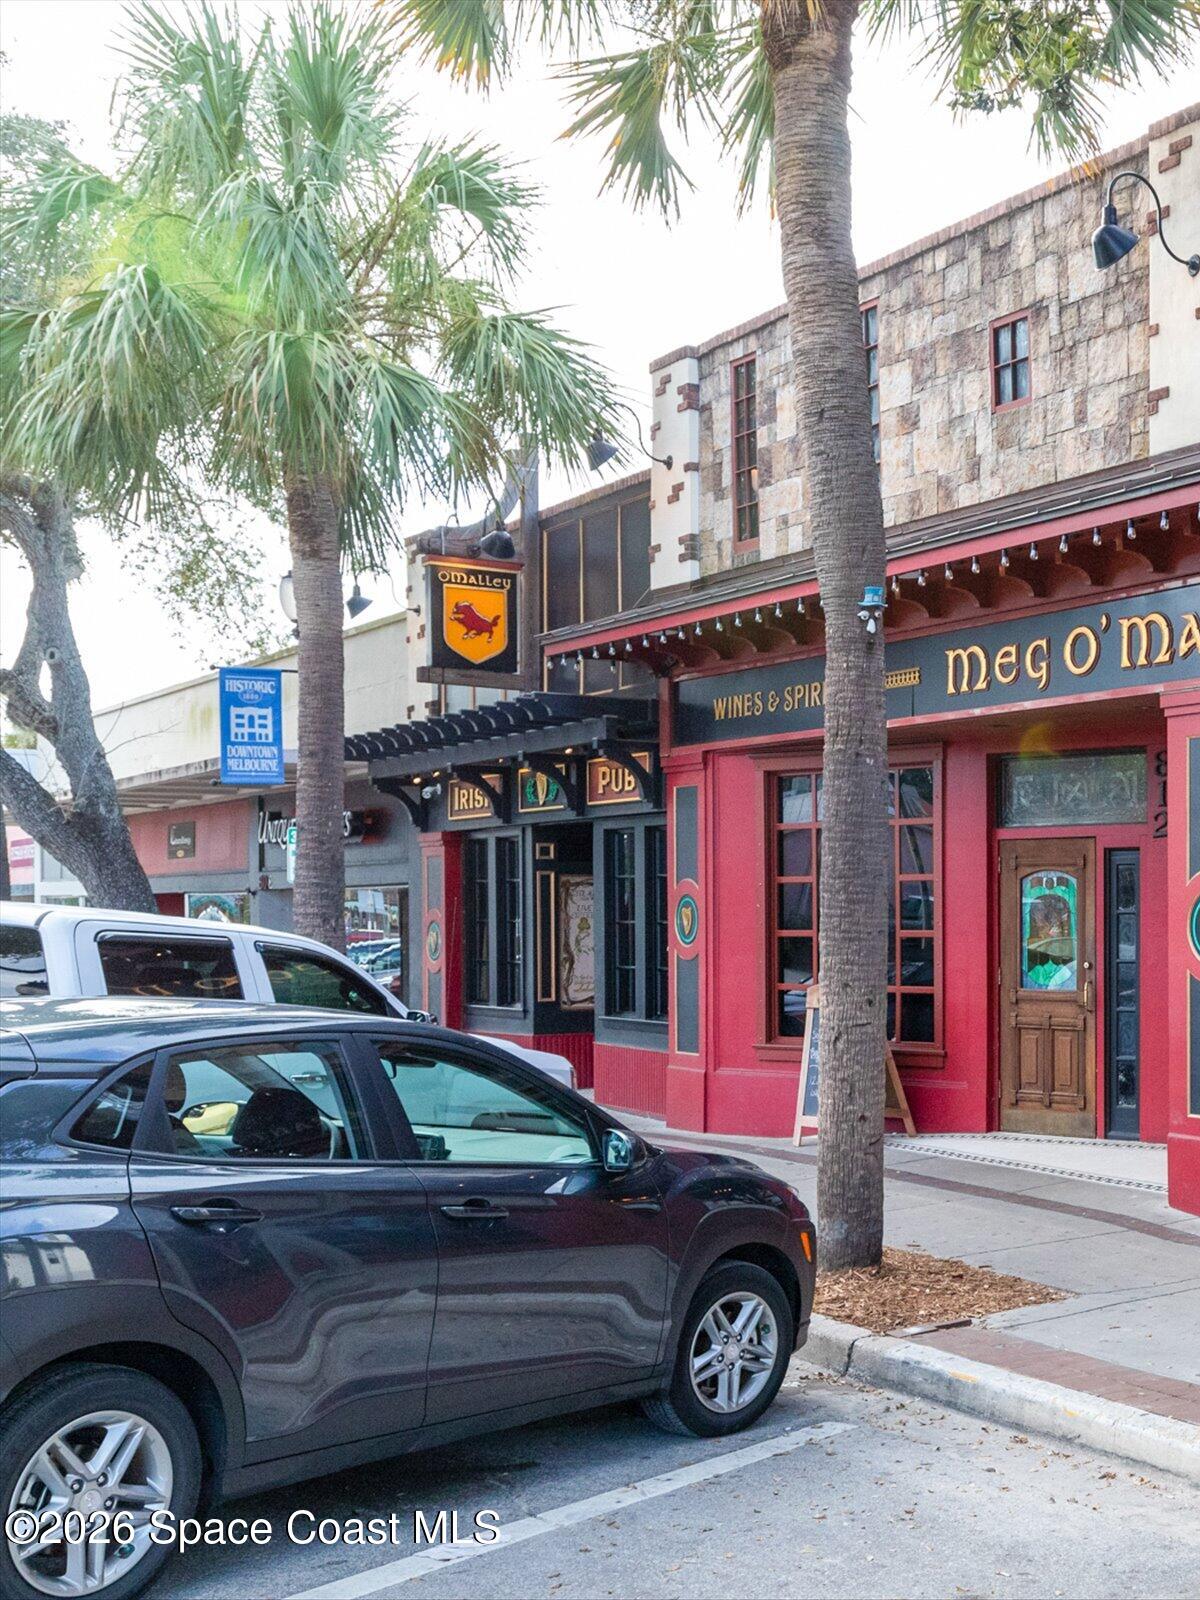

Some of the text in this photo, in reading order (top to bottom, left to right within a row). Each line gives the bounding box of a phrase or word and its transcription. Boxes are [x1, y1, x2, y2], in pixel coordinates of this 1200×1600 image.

[224, 679, 277, 694] HISTORIC
[713, 691, 764, 721] WINES
[768, 690, 780, 713] &
[226, 745, 279, 758] DOWNTOWN
[227, 758, 279, 772] MELBOURNE
[597, 766, 637, 795] PUB
